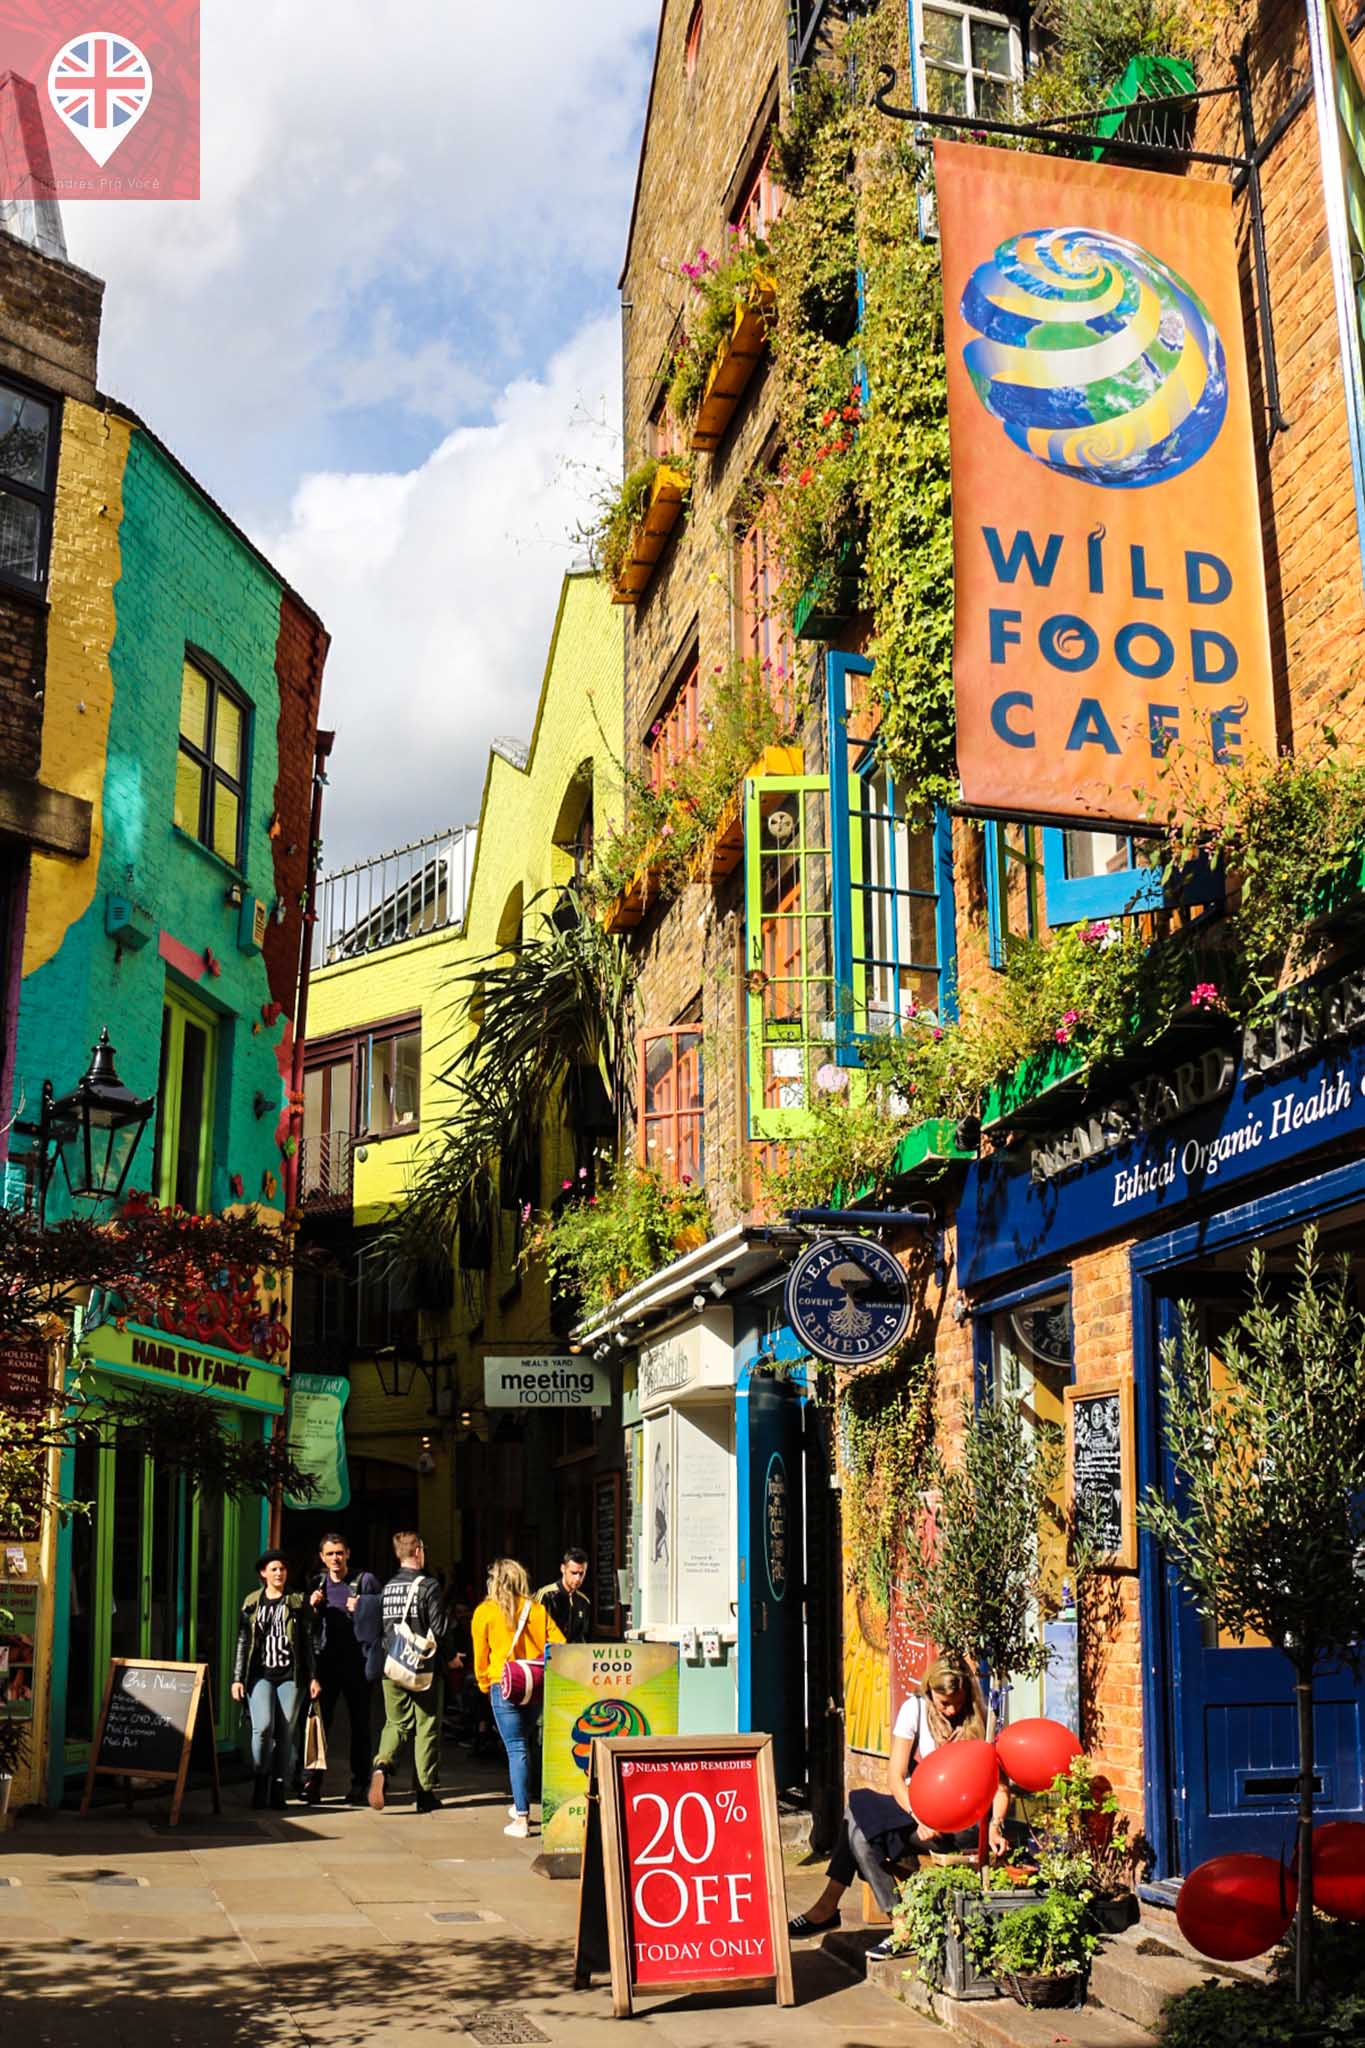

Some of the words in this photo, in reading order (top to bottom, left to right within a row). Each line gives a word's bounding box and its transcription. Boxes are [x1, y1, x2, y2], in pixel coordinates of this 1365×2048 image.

[981, 521, 1233, 605] WILD
[988, 608, 1239, 684] FOOD
[1112, 1147, 1177, 1207] Ethical
[1181, 1111, 1264, 1175] Organic
[1268, 1070, 1351, 1141] Health
[802, 1311, 898, 1353] REMEDIES
[131, 1338, 176, 1373] HAIR
[177, 1351, 202, 1379] BY
[203, 1358, 251, 1392] FAIRY
[501, 1369, 594, 1393] meeting
[519, 1390, 582, 1403] rooms
[592, 1648, 632, 1659] WILD
[592, 1662, 632, 1672] FOOD
[636, 1762, 669, 1773] NEAL'S
[671, 1762, 699, 1772] YARD
[701, 1760, 752, 1770] REMEDIES
[632, 1790, 748, 1865] 20%
[634, 1869, 752, 1928] OFF
[635, 1942, 703, 1962] TODAY
[709, 1938, 765, 1958] ONLY
